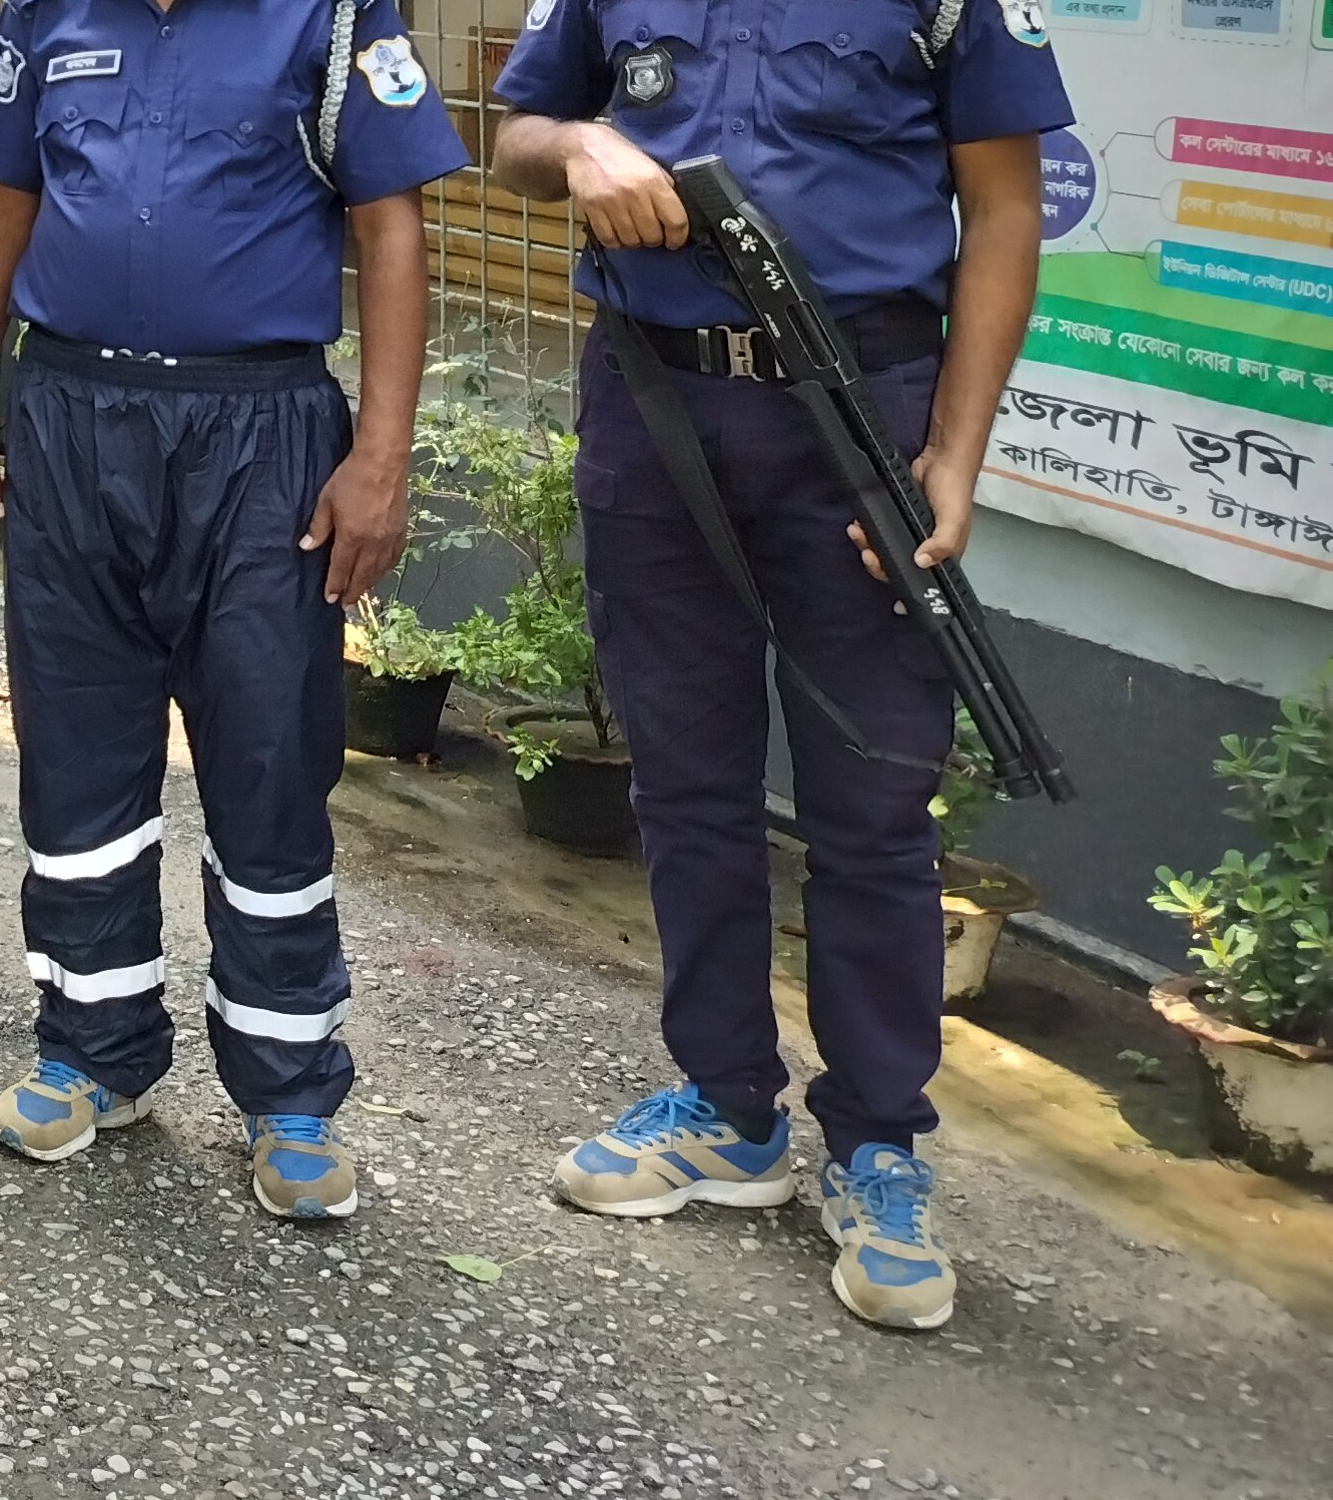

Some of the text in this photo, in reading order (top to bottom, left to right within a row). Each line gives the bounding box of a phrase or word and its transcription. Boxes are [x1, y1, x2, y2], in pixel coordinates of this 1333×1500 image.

[1178, 133, 1203, 150] কল
[1064, 161, 1089, 177] কর
[1044, 180, 1091, 200] নাগরিক
[1058, 318, 1114, 347] সংক্রান্ত
[1117, 331, 1182, 364] যেকোনো
[1186, 347, 1231, 374] সেবার
[1237, 357, 1273, 383] জন্য
[1276, 365, 1305, 390] কল
[1172, 429, 1316, 491] ভূমি
